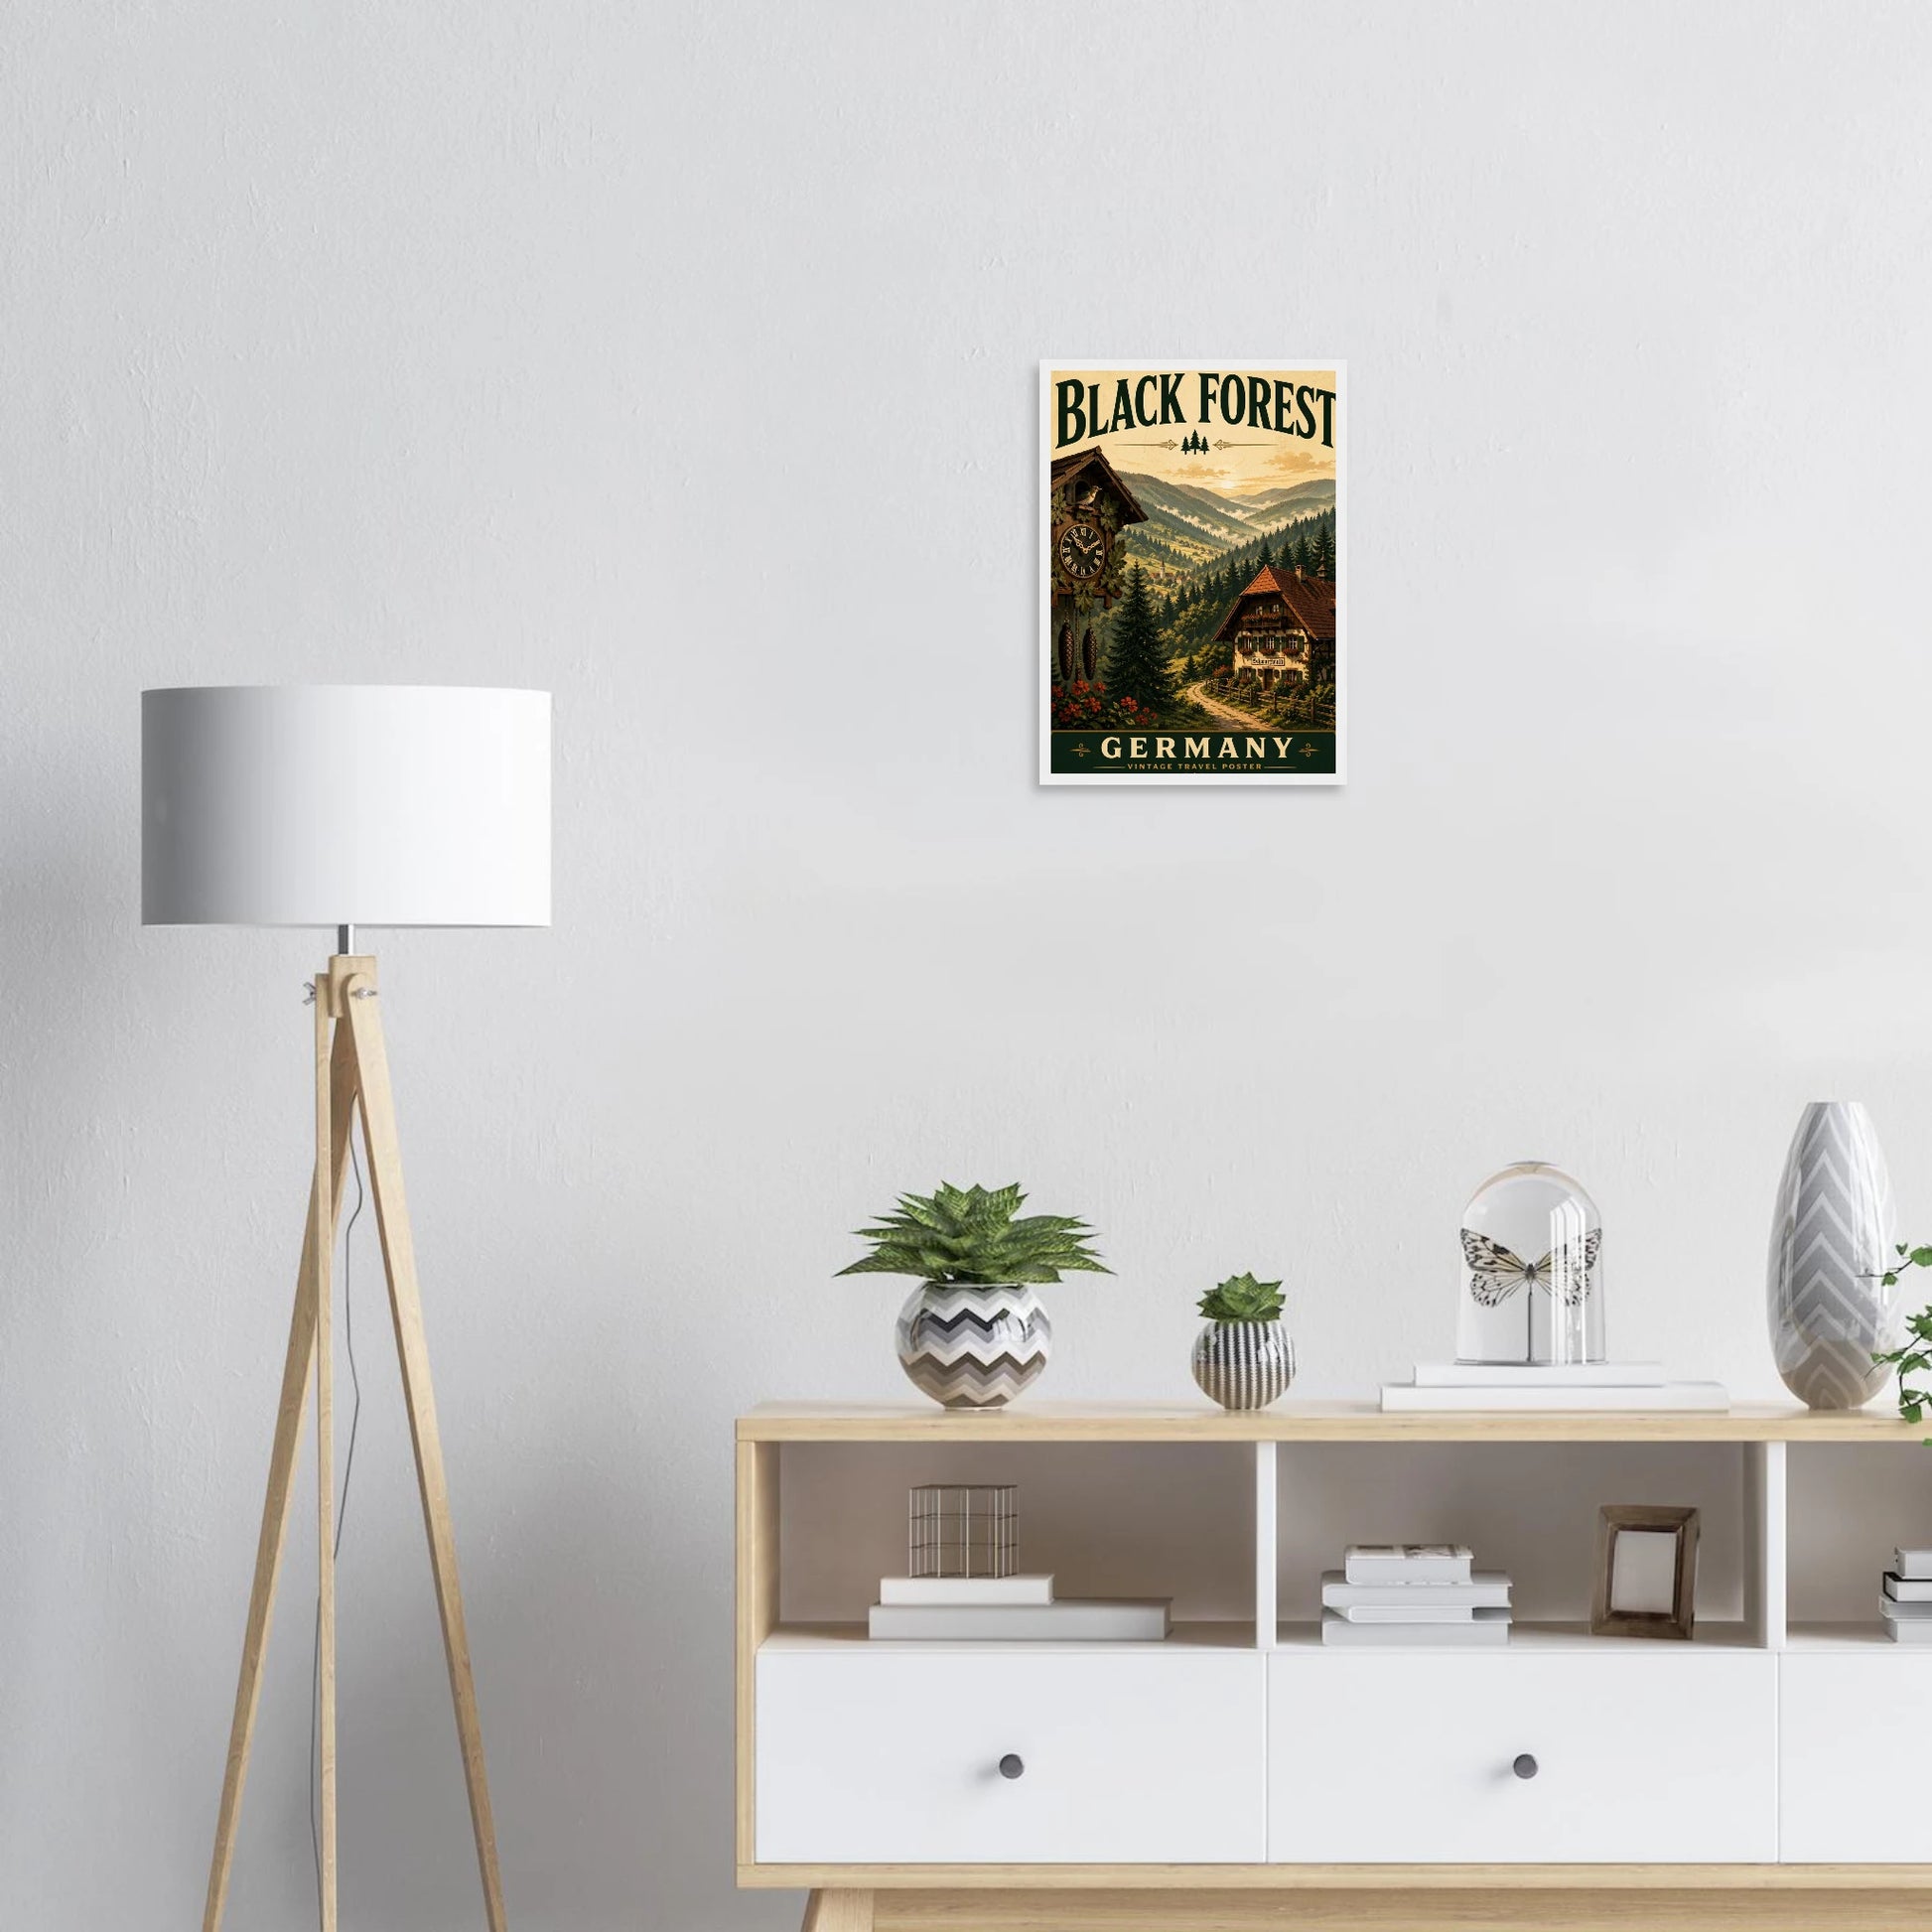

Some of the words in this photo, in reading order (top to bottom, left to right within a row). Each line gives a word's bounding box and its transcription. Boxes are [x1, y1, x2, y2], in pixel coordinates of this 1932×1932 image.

[1054, 372, 1187, 450] BLACK
[1197, 372, 1337, 449] FOREST
[1101, 736, 1294, 759] GERMANY
